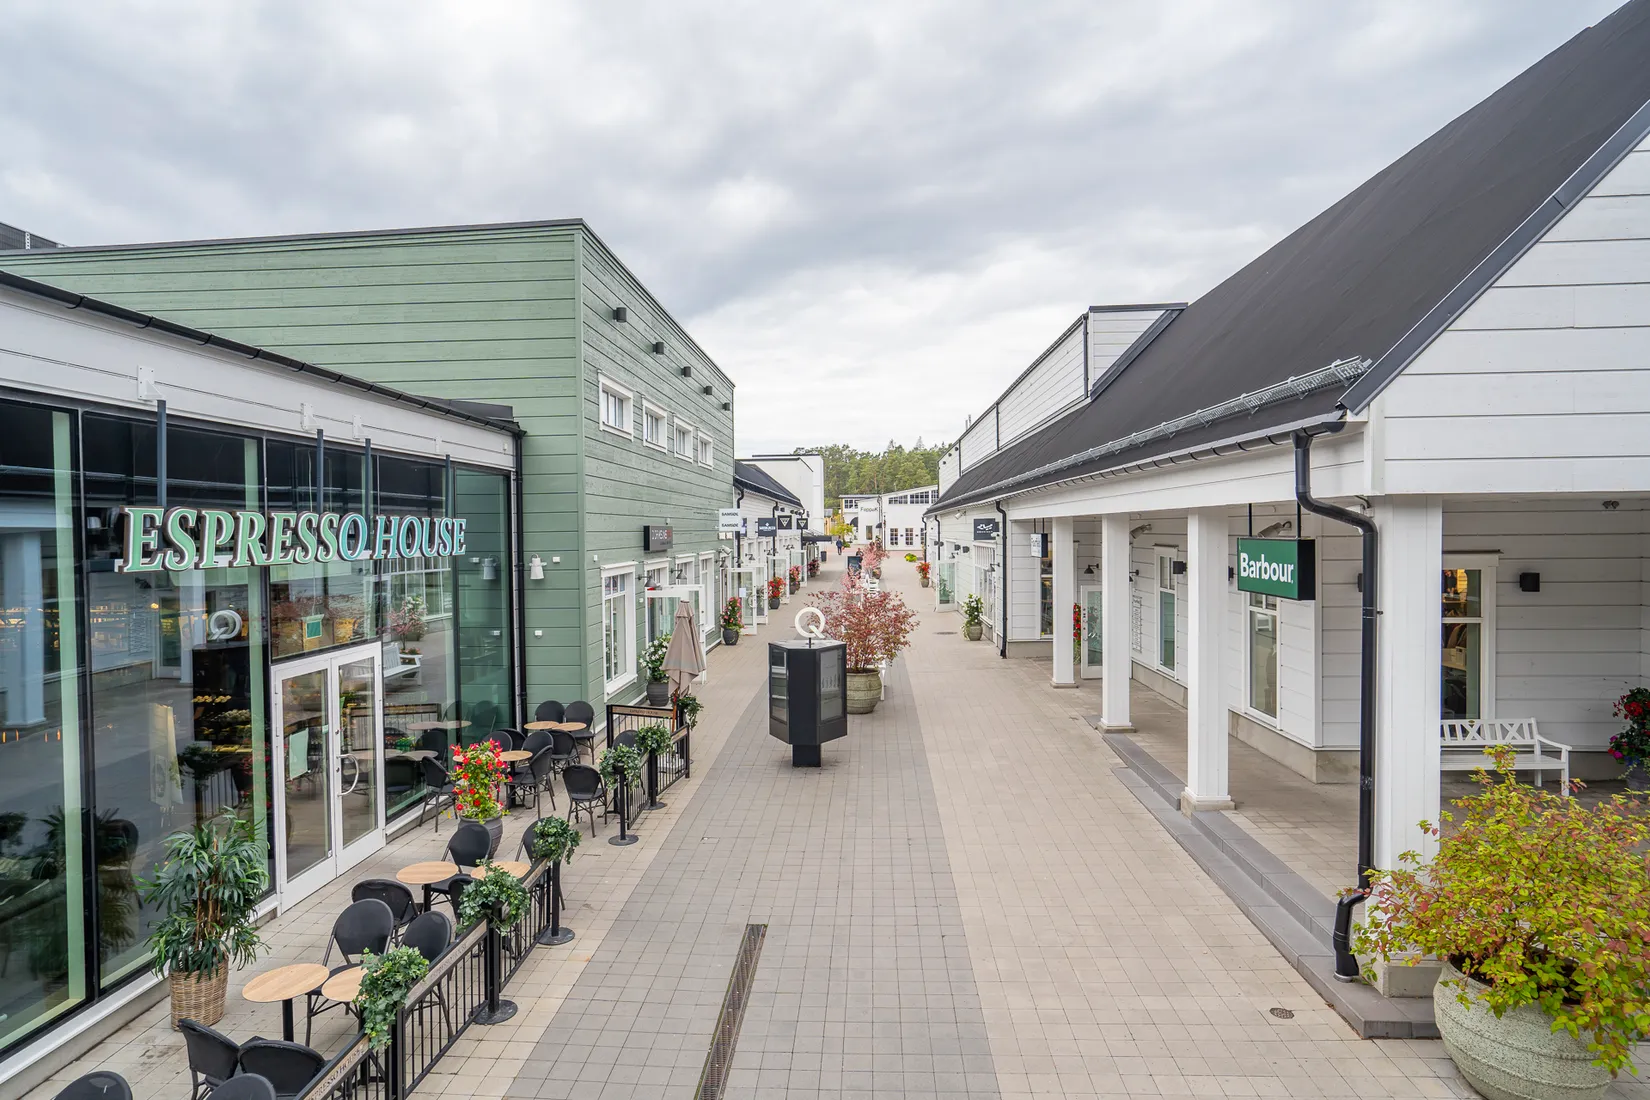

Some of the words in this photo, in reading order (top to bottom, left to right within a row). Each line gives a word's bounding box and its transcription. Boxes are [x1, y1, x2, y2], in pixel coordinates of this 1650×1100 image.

[118, 506, 367, 573] ESPRESSO
[372, 515, 466, 559] HOUSE
[1240, 552, 1294, 583] Barbour
[794, 607, 826, 638] Q
